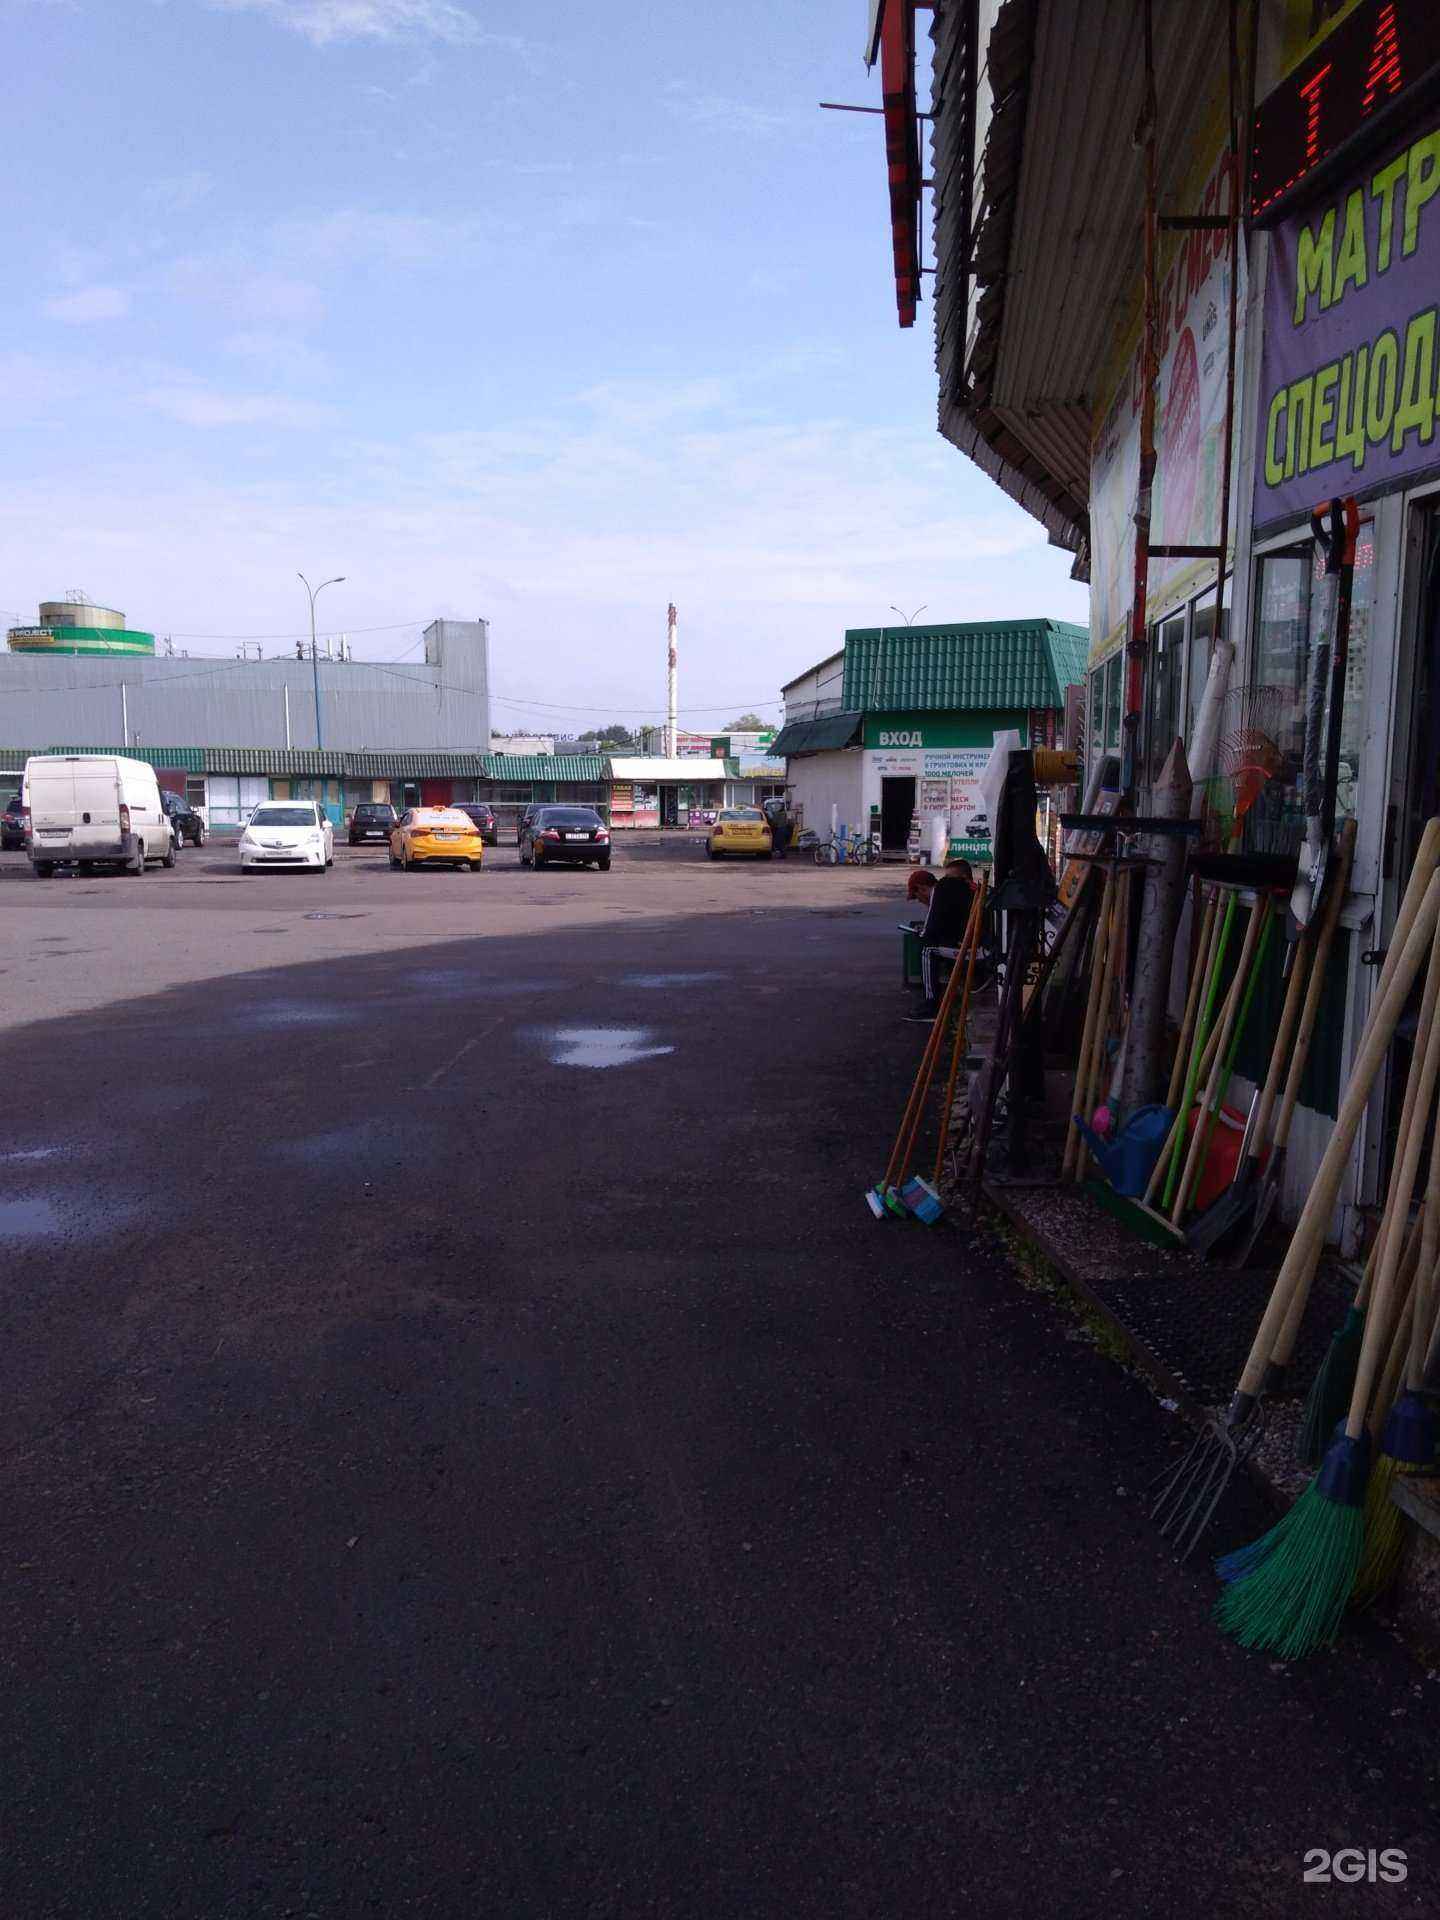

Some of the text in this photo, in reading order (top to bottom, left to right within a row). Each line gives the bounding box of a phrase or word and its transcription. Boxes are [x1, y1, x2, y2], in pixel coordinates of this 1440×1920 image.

[1264, 305, 1440, 490] СПЕЦОД
[879, 731, 923, 747] ВХОД
[942, 769, 974, 777] МЕЛОЧЕЙ
